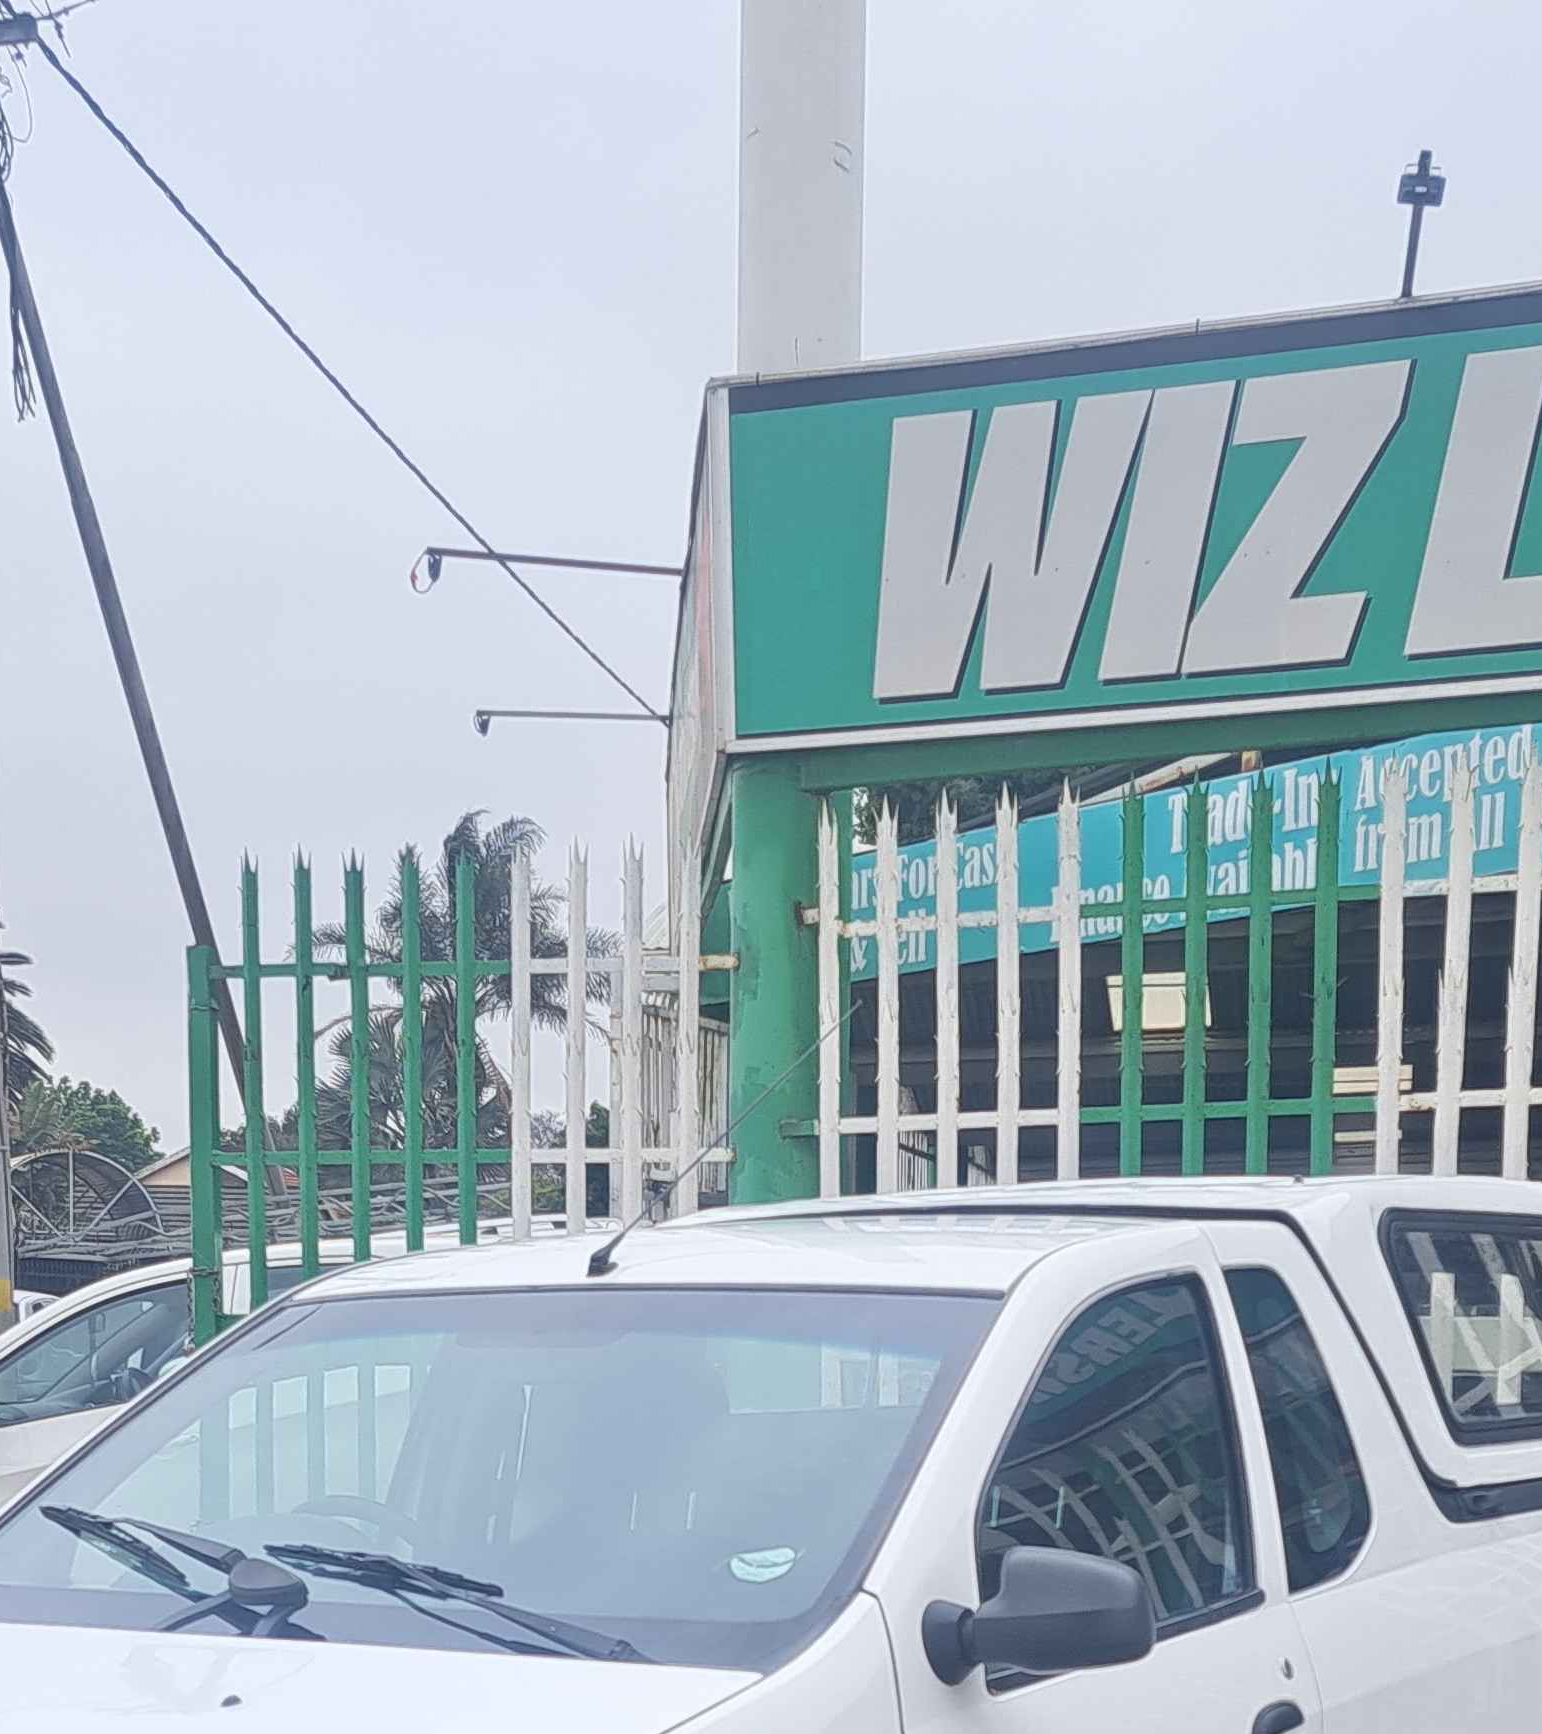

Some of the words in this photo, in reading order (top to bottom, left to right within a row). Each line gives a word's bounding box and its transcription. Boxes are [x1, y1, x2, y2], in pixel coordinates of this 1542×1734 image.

[873, 359, 1414, 702] WIZ
[1168, 768, 1320, 854] Tad-In
[1354, 812, 1442, 872] frm
